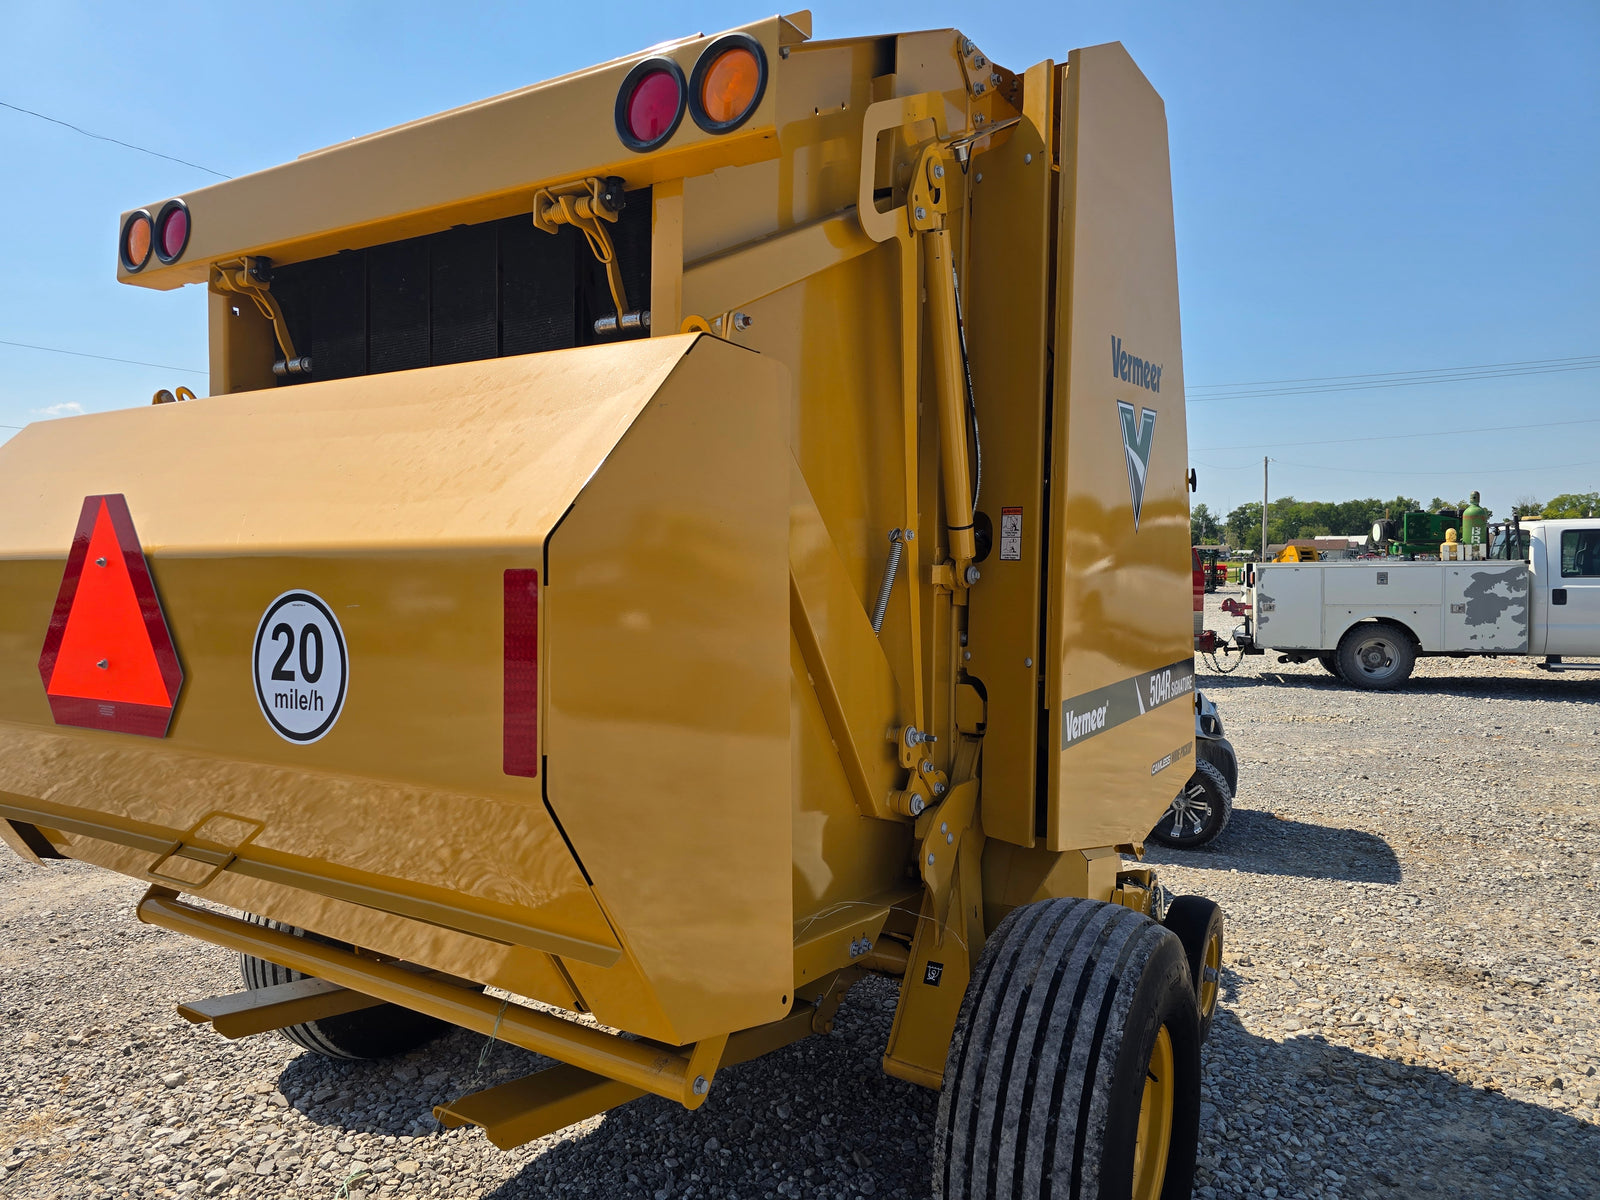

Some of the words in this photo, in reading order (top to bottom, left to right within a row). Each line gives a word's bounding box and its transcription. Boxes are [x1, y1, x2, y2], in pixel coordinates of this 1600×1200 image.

[1111, 335, 1161, 393] Vermeer
[271, 622, 324, 684] 20
[274, 688, 324, 712] mile/h
[1149, 669, 1171, 707] 504R
[1065, 705, 1107, 742] Vermeer
